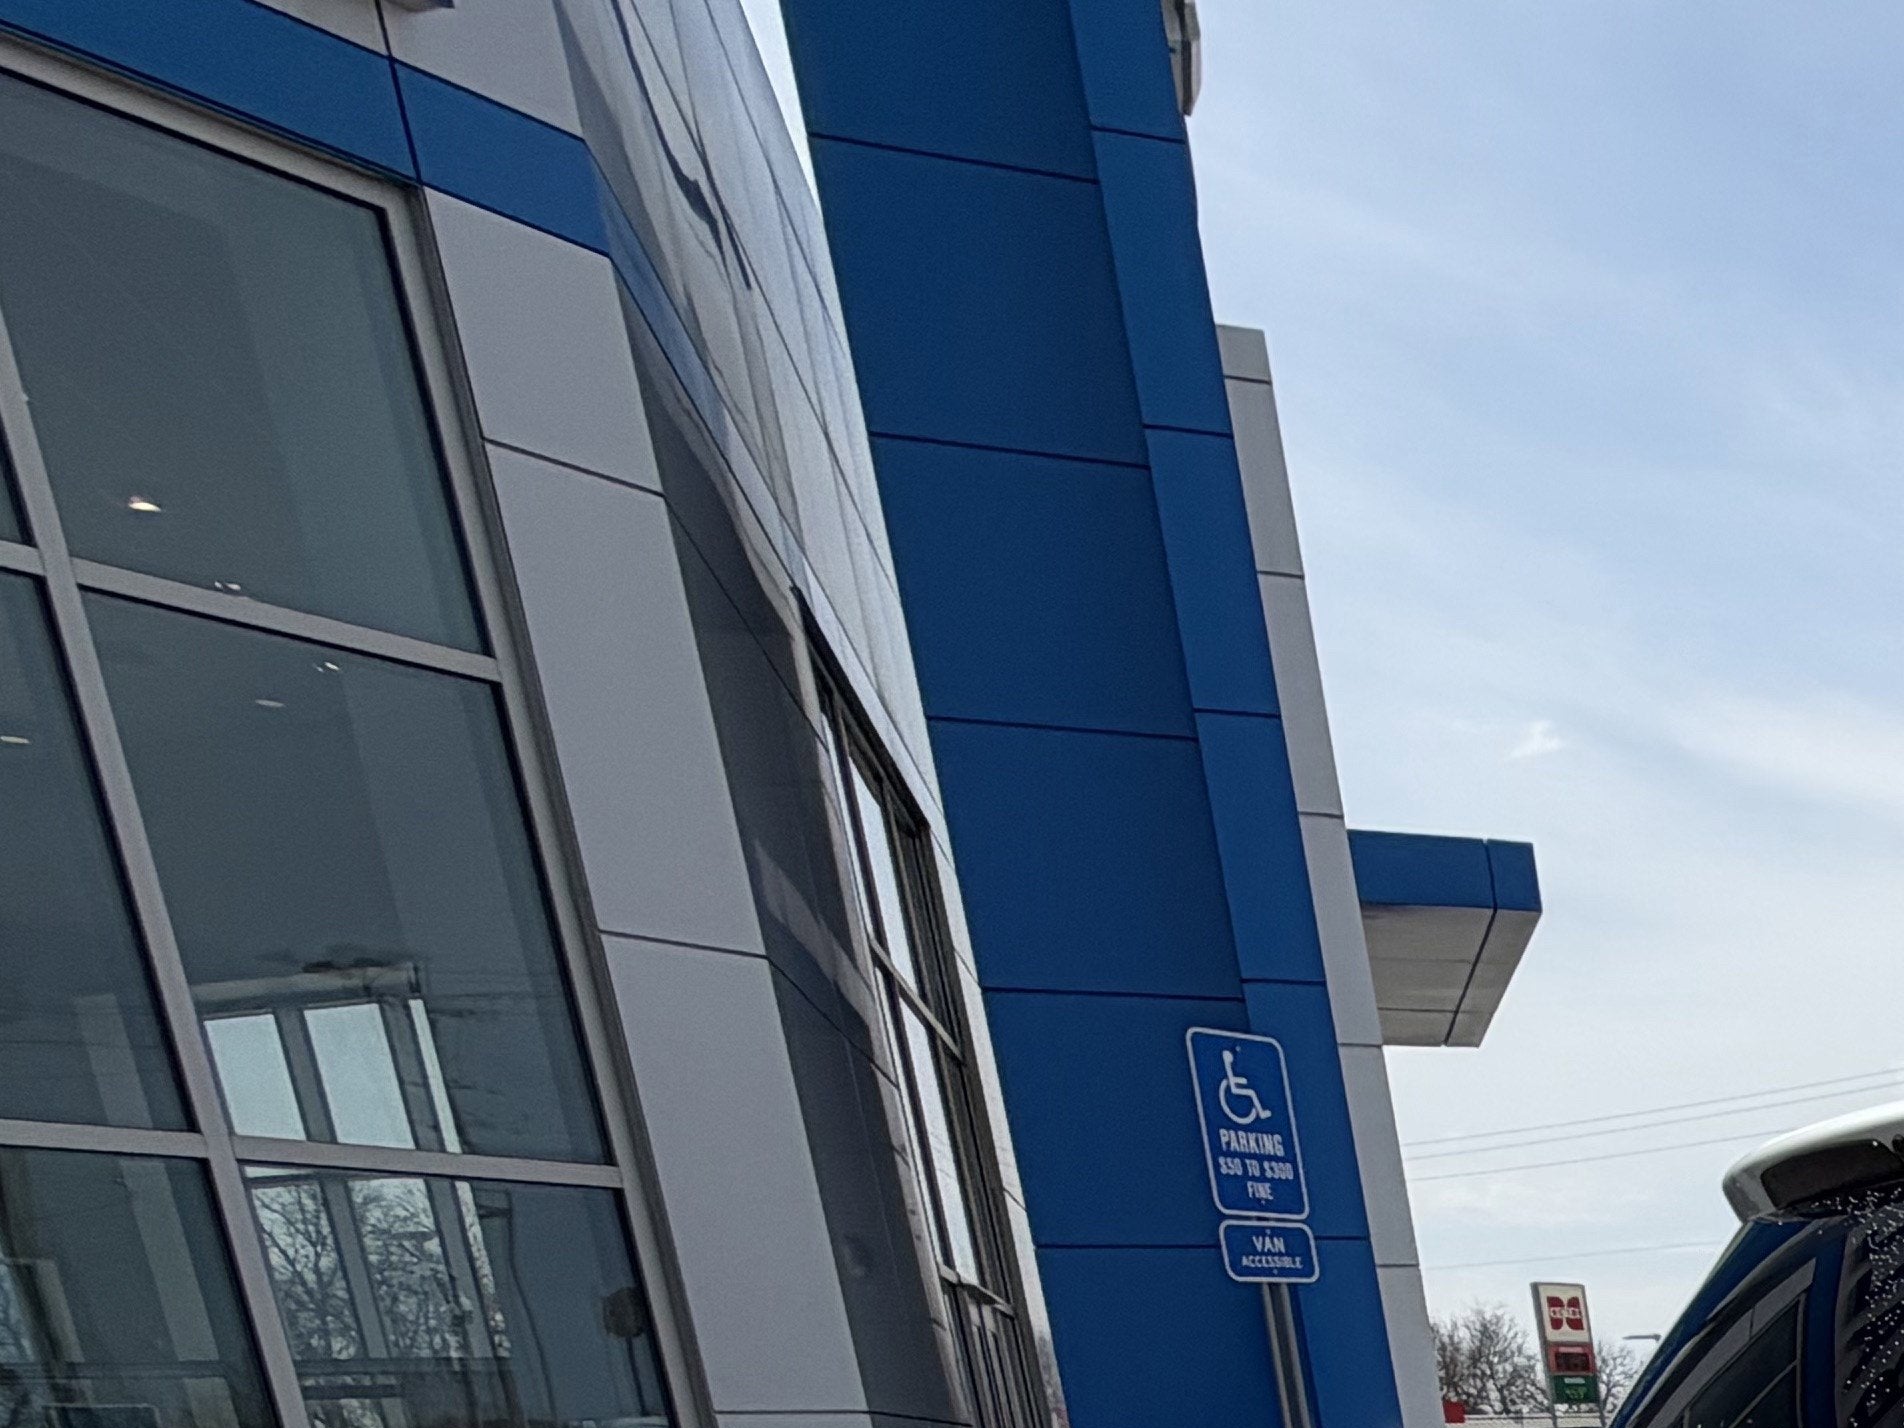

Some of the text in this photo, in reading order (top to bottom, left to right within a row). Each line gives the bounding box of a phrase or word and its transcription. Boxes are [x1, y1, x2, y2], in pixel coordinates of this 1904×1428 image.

[1219, 1128, 1285, 1157] PARKING
[1244, 1158, 1261, 1177] TO
[1246, 1181, 1274, 1200] FINE
[1252, 1235, 1286, 1254] VAN
[1241, 1255, 1303, 1269] ACCESSIBLE
